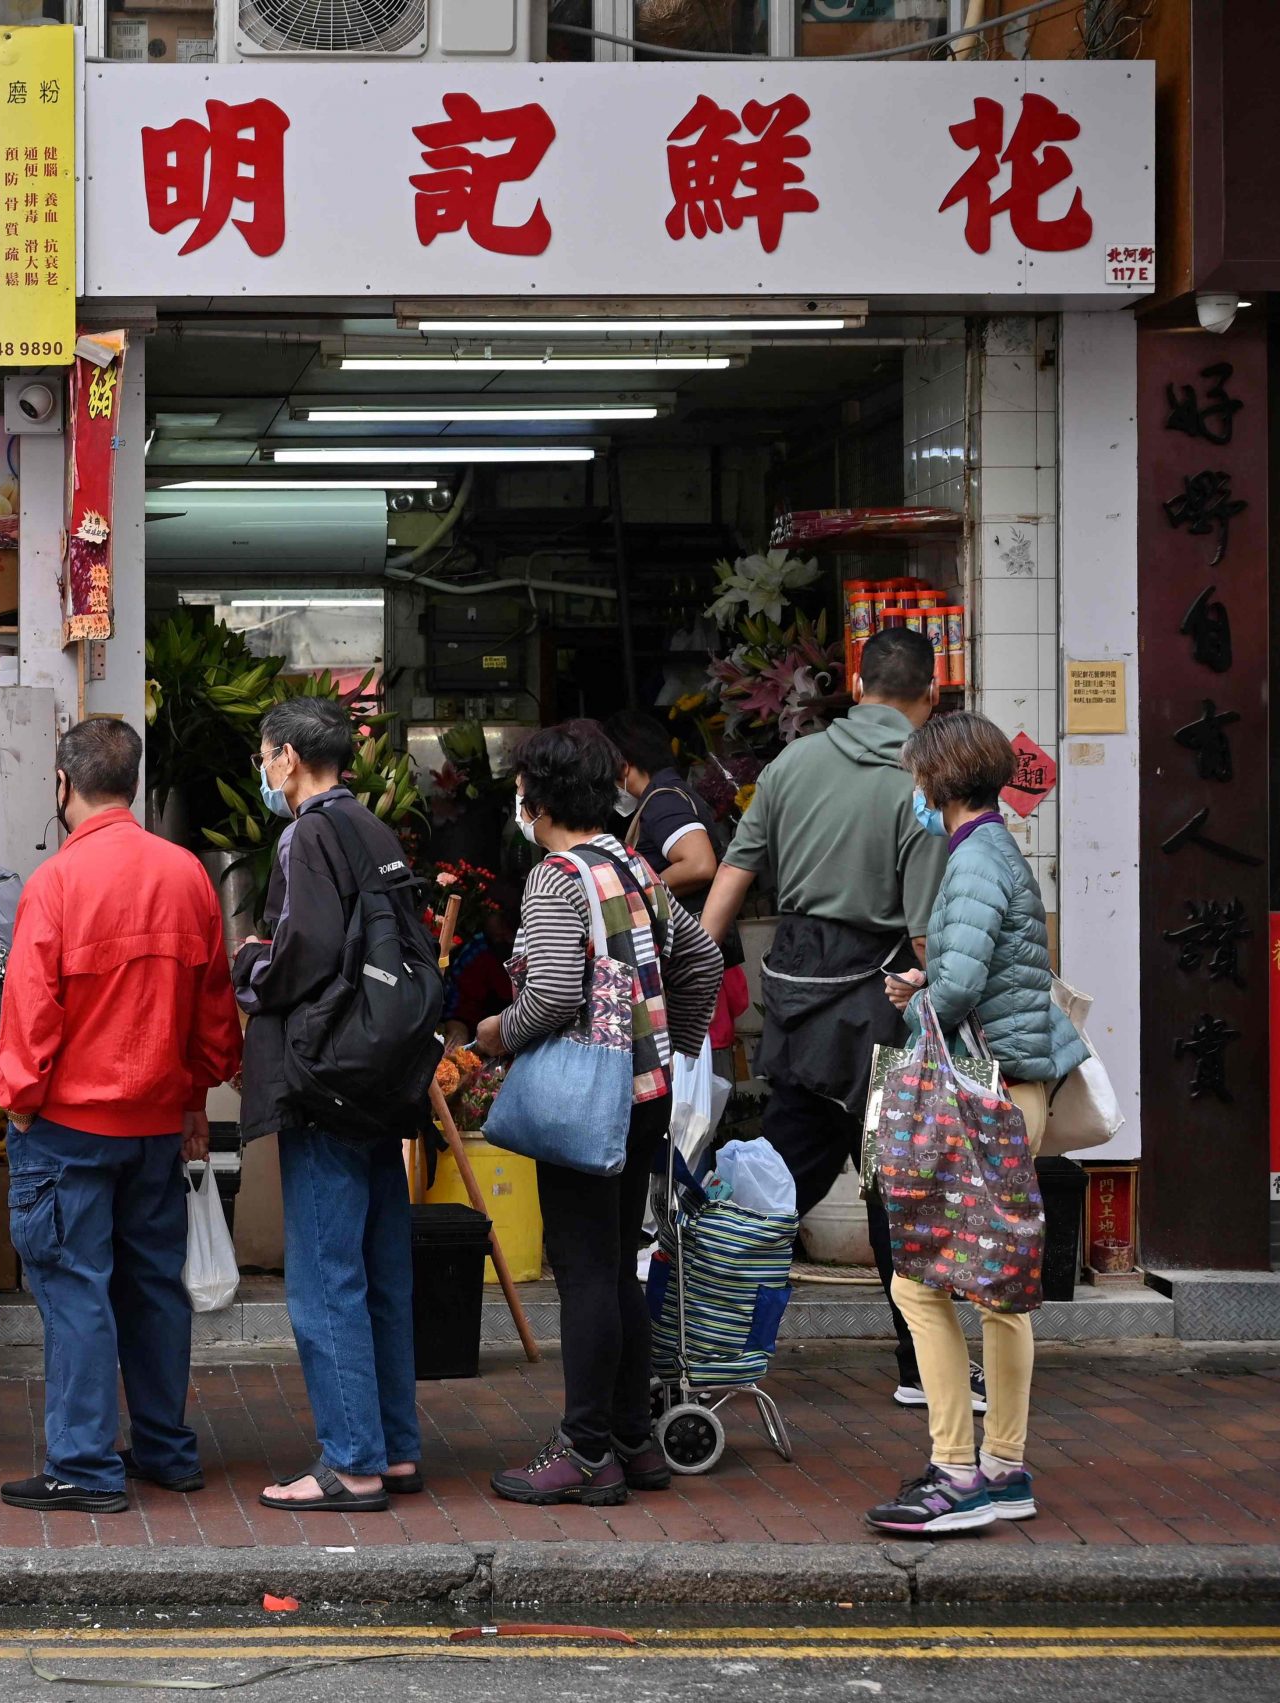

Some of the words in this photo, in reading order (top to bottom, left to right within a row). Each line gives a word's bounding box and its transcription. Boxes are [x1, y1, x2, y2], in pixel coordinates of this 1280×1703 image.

[24, 146, 38, 178] 通便
[43, 146, 58, 177] 健腦
[141, 91, 1093, 258] 明記鮮花
[4, 146, 19, 286] 預防骨質疏鬆
[24, 192, 38, 224] 排毒
[44, 192, 58, 223] 養血
[24, 239, 38, 286] 滑大腸
[44, 238, 58, 286] 抗衰老
[19, 341, 64, 357] 9890
